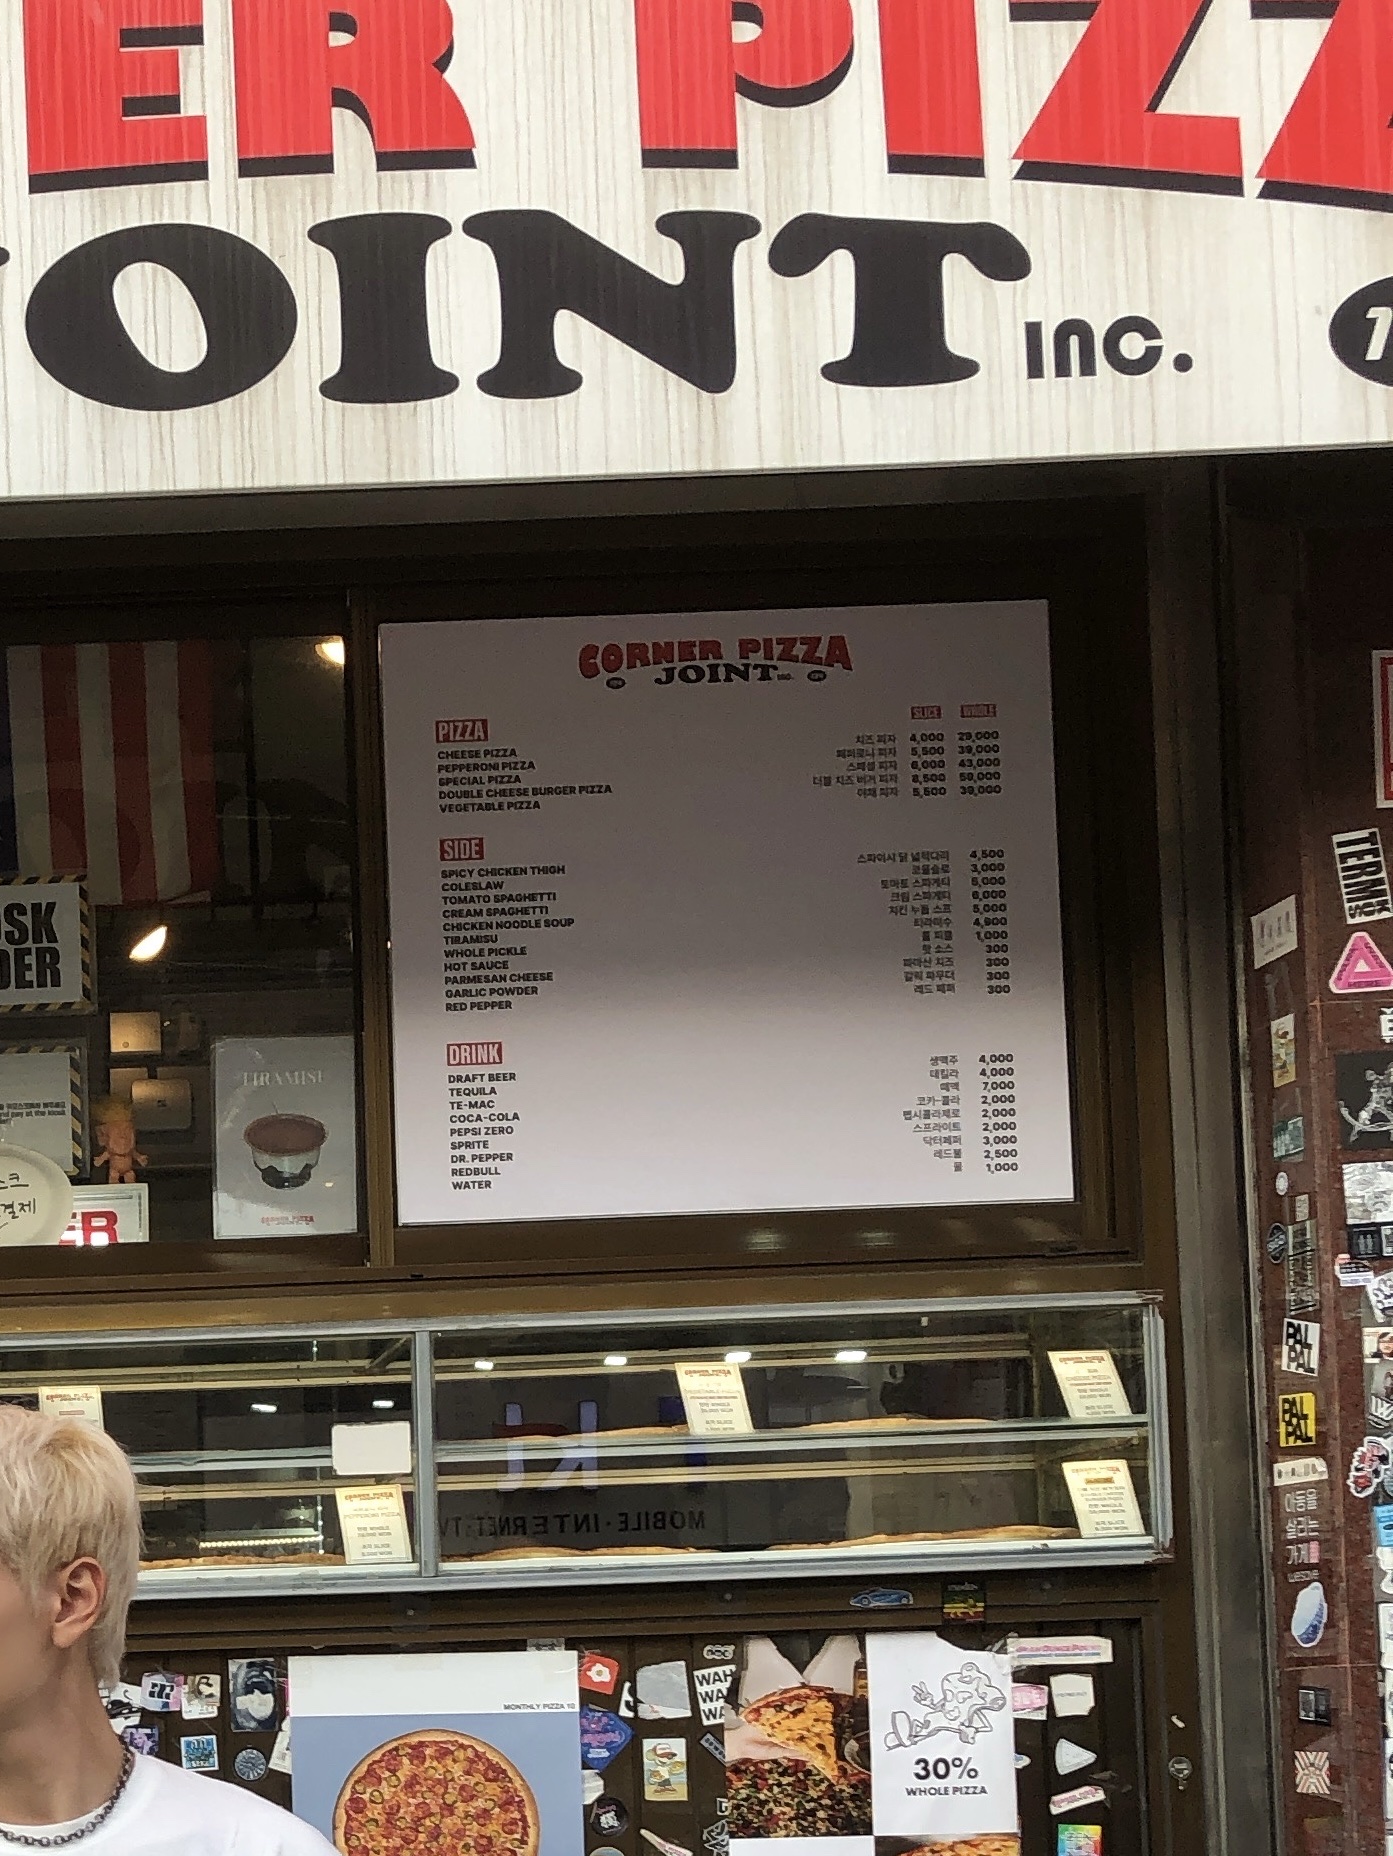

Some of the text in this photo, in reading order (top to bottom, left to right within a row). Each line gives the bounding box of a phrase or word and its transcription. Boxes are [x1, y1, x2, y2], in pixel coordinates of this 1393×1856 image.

[578, 635, 853, 679] CORNER PIZZA
[654, 663, 778, 685] JOINT
[438, 721, 485, 742] PIZZA
[438, 748, 517, 760] CHEESE PIZZA
[438, 761, 536, 773] PEPPERONI PIZZA
[438, 775, 521, 786] SPECIAL PIZZA
[439, 784, 612, 800] DOUBLE CHEESE BURGER PIZZA
[439, 801, 541, 813] VEGETABLE PIZZA
[443, 839, 480, 860] SIDE
[441, 865, 565, 879] SPICY CHICKEN THIGH
[441, 881, 504, 892] COLESLAW
[442, 892, 556, 906] TOMATO SPAGHETTI
[443, 906, 548, 919] CREAM SPAGHETTI
[443, 918, 574, 932] CHICKEN NOODLE SOUP
[443, 934, 498, 945] TIRAMISU
[444, 946, 527, 959] WHOLE PICKLE
[444, 961, 509, 972] HOT SAUCE
[445, 972, 553, 985] PARMESAN CHEESE
[445, 986, 538, 999] GARLIC POWDER
[446, 1000, 512, 1012] RED PEPPER
[449, 1044, 500, 1065] DRINK
[448, 1073, 516, 1084] DRAFT BEER
[449, 1087, 497, 1097] TEQUILA
[449, 1100, 495, 1110] TE-MAC
[449, 1112, 520, 1123] COCA-COLA
[450, 1126, 514, 1137] PEPSI ZERO
[451, 1140, 489, 1150] SPRITE
[451, 1153, 513, 1164] DR. PEPPER
[451, 1167, 501, 1177] REDBULL
[452, 1180, 492, 1190] WATER
[503, 1702, 540, 1710] MONTHLY
[543, 1702, 568, 1710] PIZZA
[913, 1756, 980, 1781] 30%
[905, 1784, 989, 1798] WHOLE PIZZA
